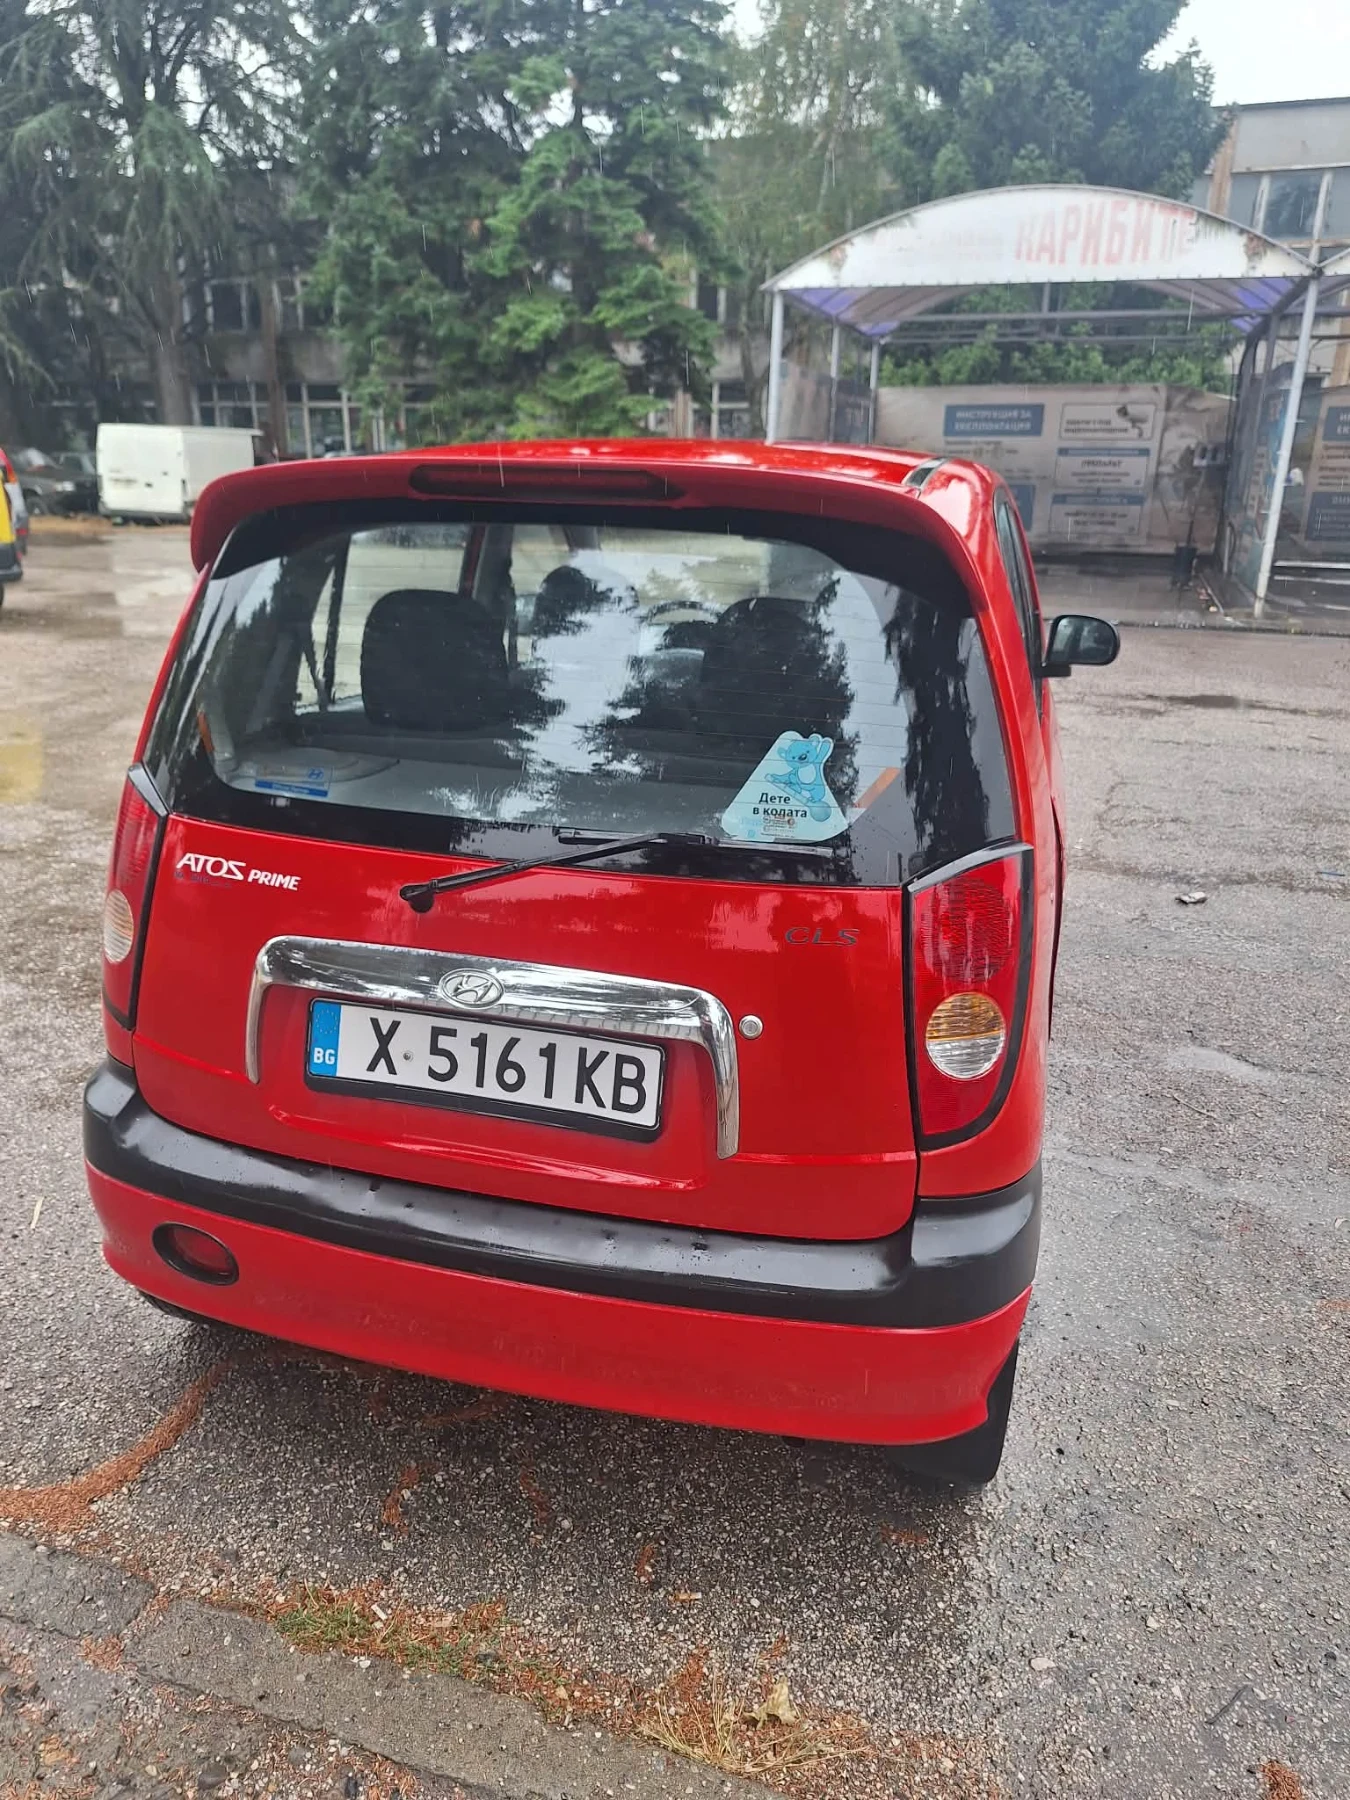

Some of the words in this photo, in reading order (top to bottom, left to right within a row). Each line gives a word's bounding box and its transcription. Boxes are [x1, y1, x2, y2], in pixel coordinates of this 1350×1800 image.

[758, 792, 791, 805] Дете
[752, 806, 760, 815] в
[763, 807, 808, 818] колата
[176, 852, 247, 881] ATOS
[247, 869, 302, 891] PRIME
[784, 926, 860, 947] CLS
[313, 1047, 336, 1066] BG
